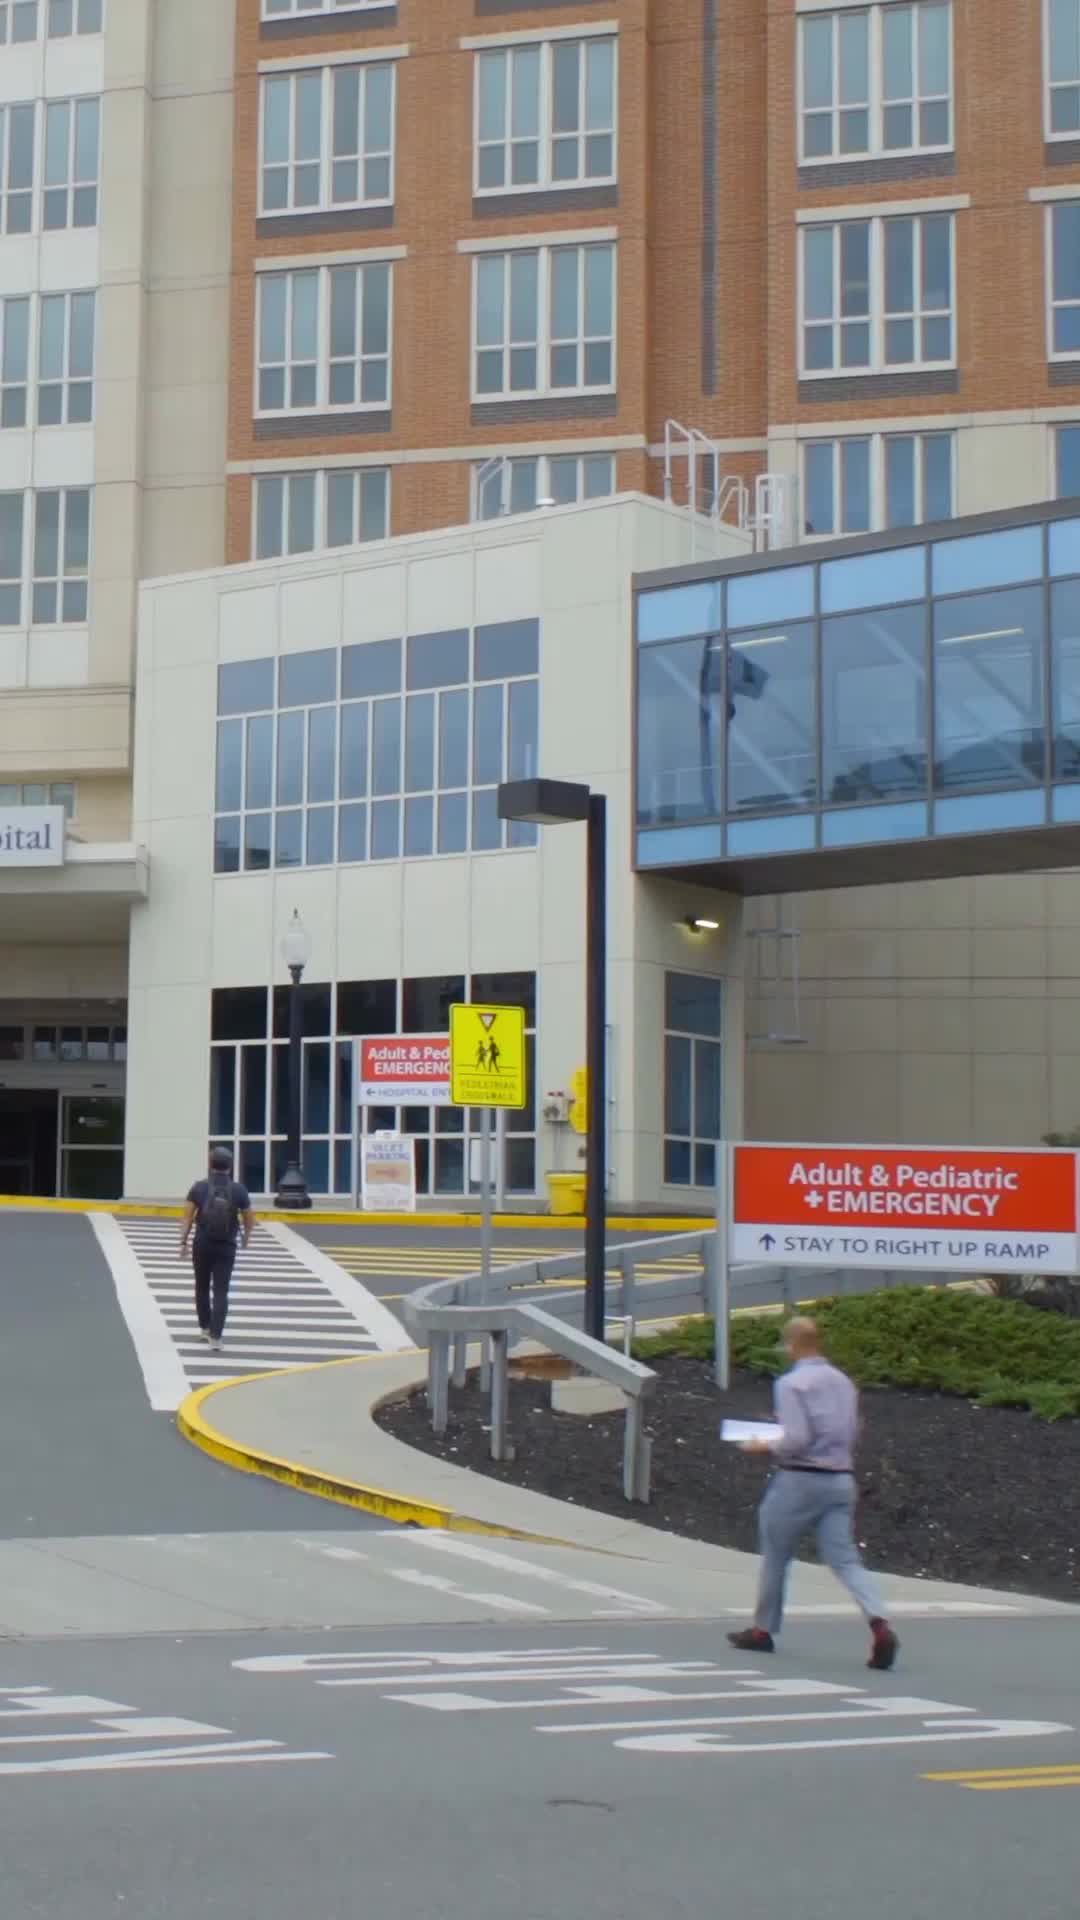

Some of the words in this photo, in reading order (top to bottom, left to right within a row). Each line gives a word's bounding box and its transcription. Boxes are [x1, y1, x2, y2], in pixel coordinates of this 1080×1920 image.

[0, 824, 55, 850] ital
[368, 1046, 407, 1060] Adult
[409, 1046, 421, 1060] &
[789, 1162, 862, 1187] Adult
[869, 1164, 889, 1188] &
[896, 1164, 1019, 1190] Pediatric
[827, 1190, 1000, 1217] EMERGENCY
[784, 1236, 835, 1252] STAY
[840, 1238, 869, 1254] TO
[875, 1239, 942, 1256] RIGHT
[947, 1242, 977, 1257] UP
[985, 1243, 1050, 1259] RAMP
[231, 1646, 1074, 1753] CLEAR
